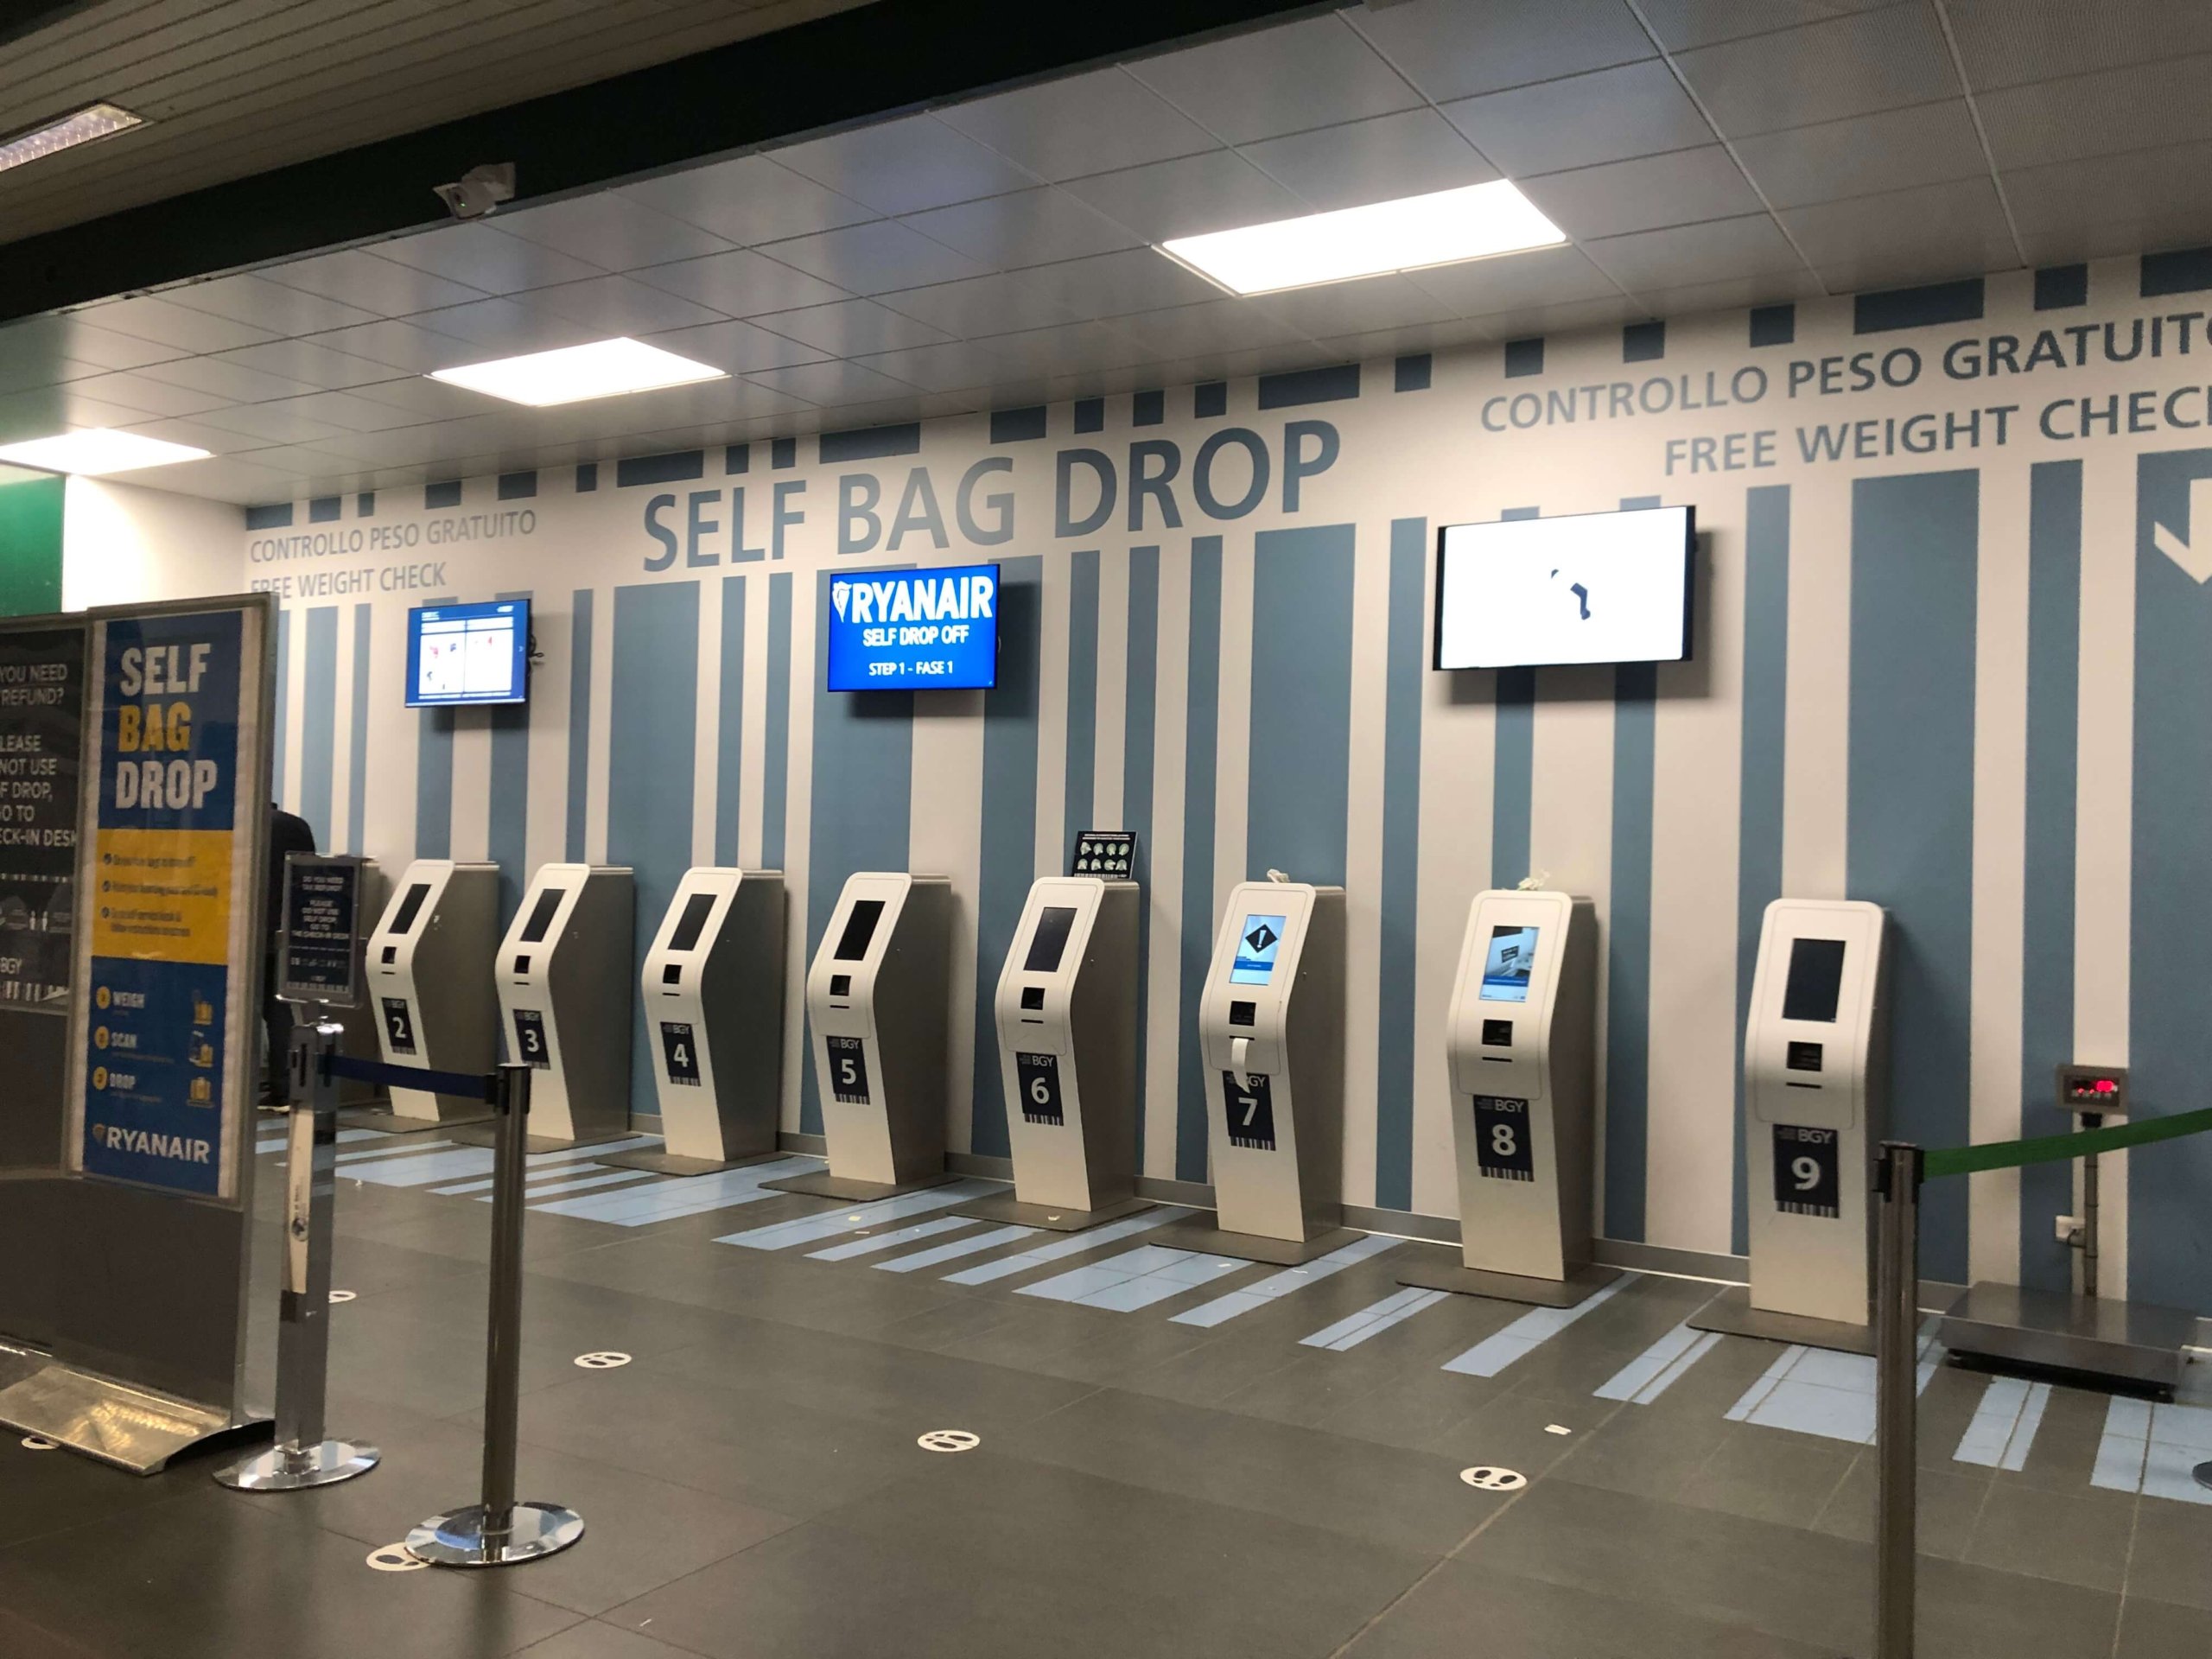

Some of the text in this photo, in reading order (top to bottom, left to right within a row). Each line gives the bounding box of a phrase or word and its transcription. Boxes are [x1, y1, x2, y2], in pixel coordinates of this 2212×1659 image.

[1481, 312, 2212, 432] CONTROLLO PESO GRATUIT
[1665, 385, 2212, 476] FREE WEIGHT CHEC
[643, 419, 1340, 572] SELF BAG DROP
[251, 509, 537, 563] CONTROLLO PESO GRATUITO
[251, 561, 448, 599] FREE WEIGHT CHECK
[851, 575, 995, 623] RYANAIR
[862, 625, 969, 647] SELF DROP OFF
[29, 664, 68, 681] NEED
[120, 643, 211, 696] SELF
[869, 663, 897, 676] STEP
[899, 662, 906, 675] 1
[916, 661, 944, 675] FASE
[947, 661, 953, 674] 1
[1, 687, 65, 705] REFUND?
[118, 702, 192, 752] BAG
[0, 734, 41, 752] LEASE
[0, 758, 57, 775] NOT USE
[12, 781, 53, 802] DROP,
[116, 760, 217, 809] DROP
[16, 804, 35, 822] TO
[392, 1016, 406, 1039] 2
[524, 1029, 539, 1052] 3
[840, 1039, 859, 1049] BGY
[673, 1043, 689, 1067] 4
[1032, 1056, 1054, 1066] BGY
[842, 1058, 856, 1084] 5
[1031, 1077, 1050, 1104] 6
[1238, 1097, 1258, 1126] 7
[1495, 1099, 1524, 1113] BGY
[106, 1127, 210, 1164] RYANAIR
[1492, 1123, 1516, 1156] 8
[1798, 1128, 1833, 1144] BGY
[1791, 1155, 1821, 1191] 9
